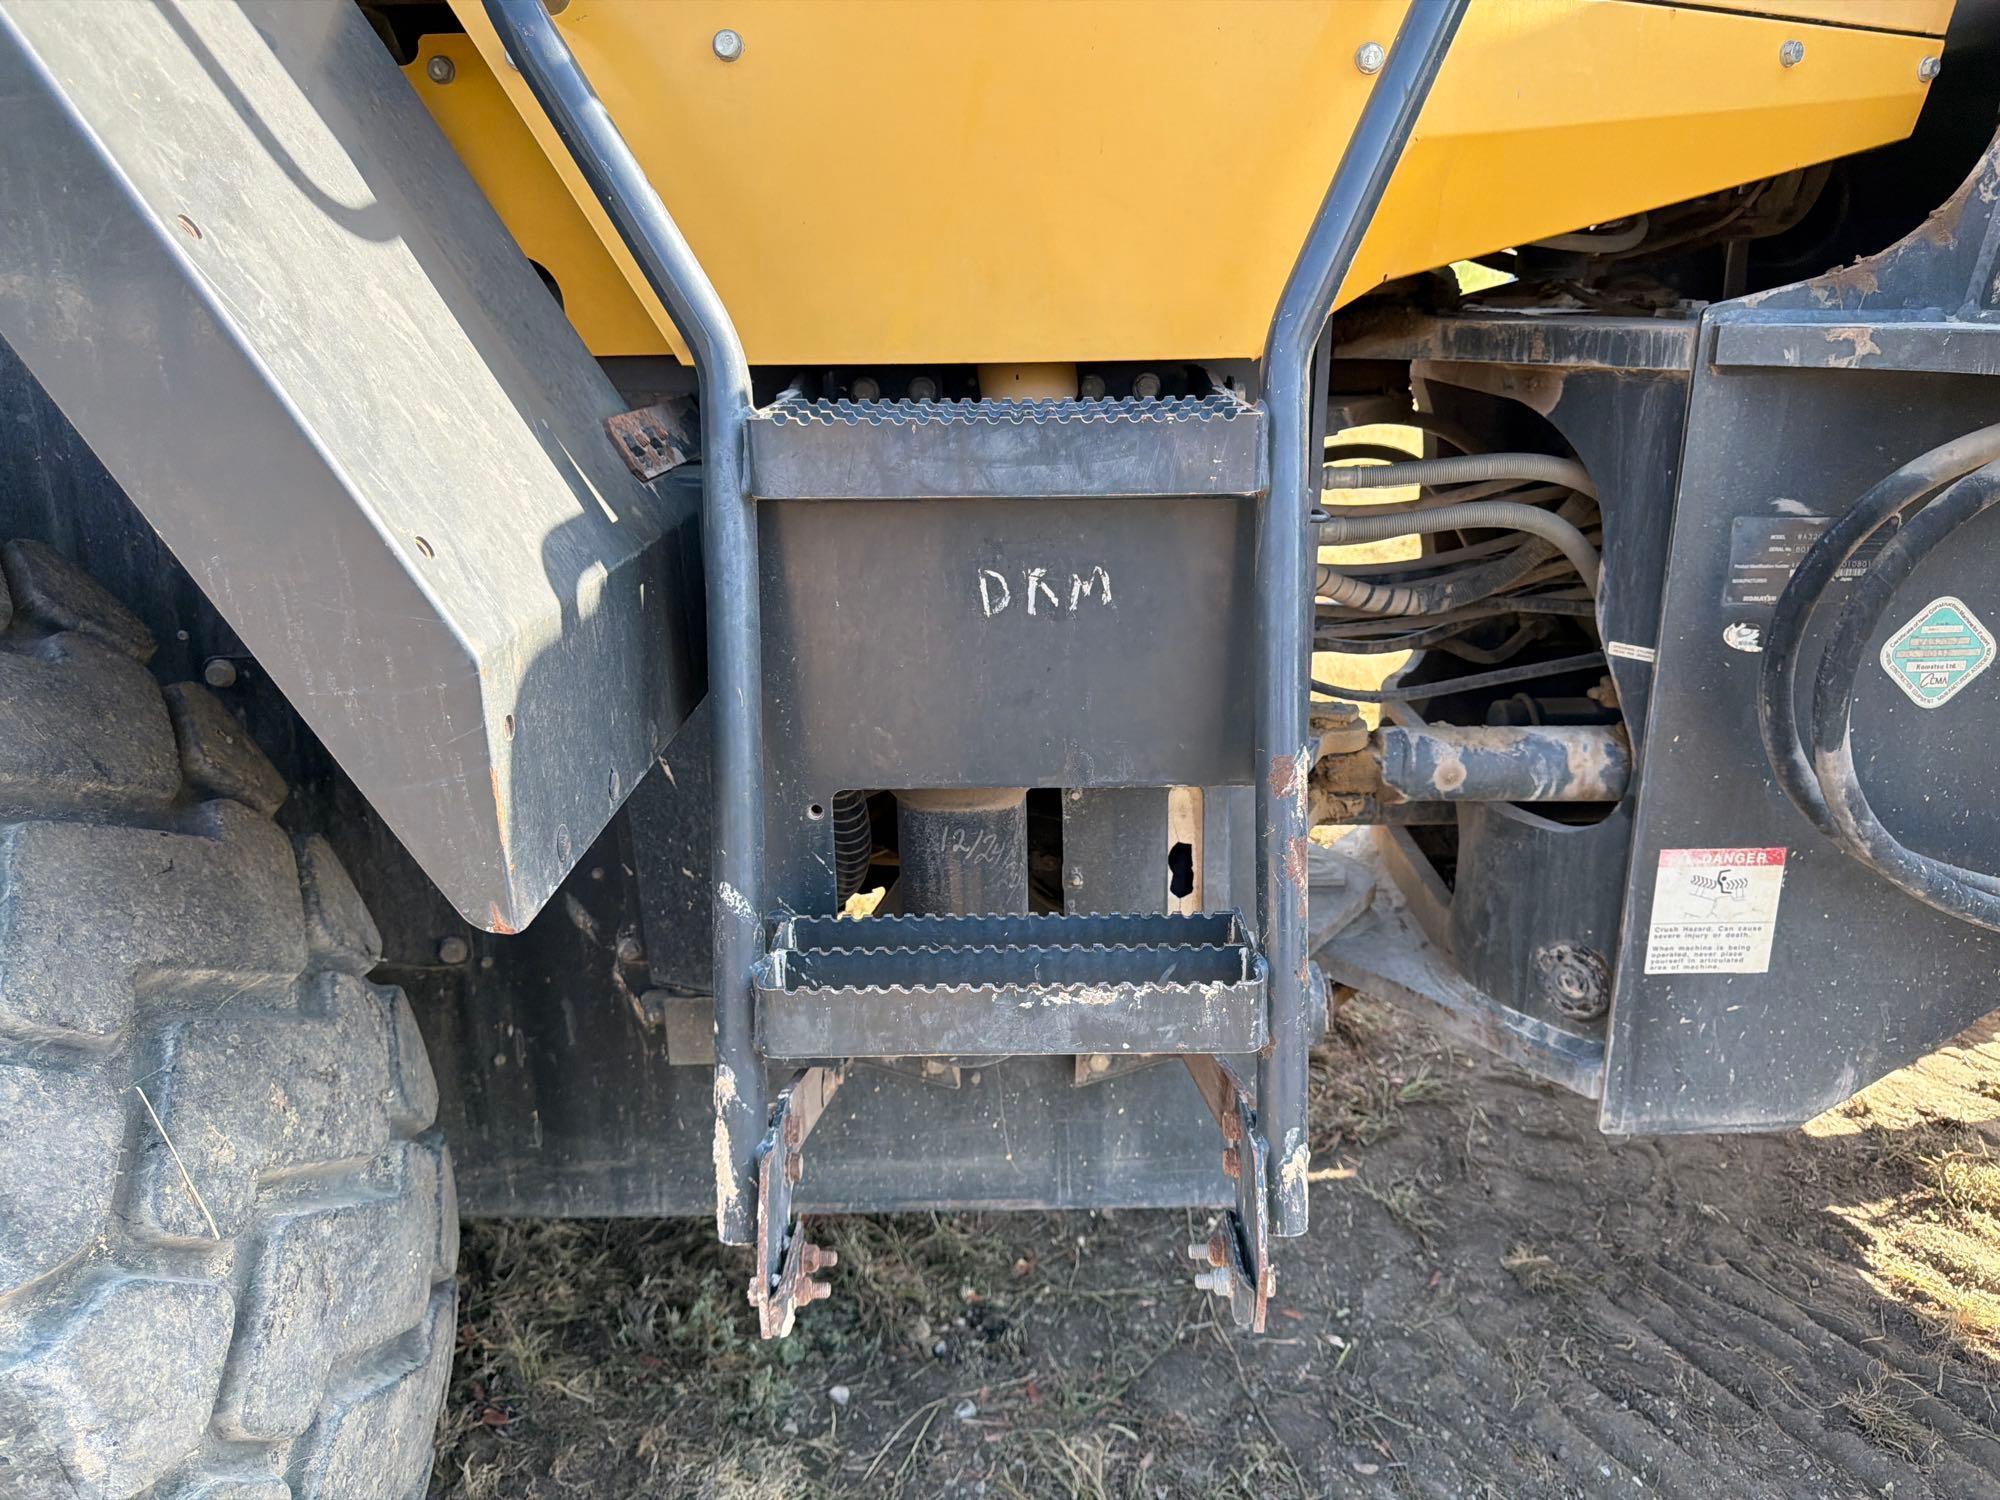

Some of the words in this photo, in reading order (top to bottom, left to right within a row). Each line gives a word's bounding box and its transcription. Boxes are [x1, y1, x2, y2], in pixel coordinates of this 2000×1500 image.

[1701, 852, 1768, 864] DANGER
[1684, 932, 1708, 940] injury
[1728, 944, 1751, 952] being
